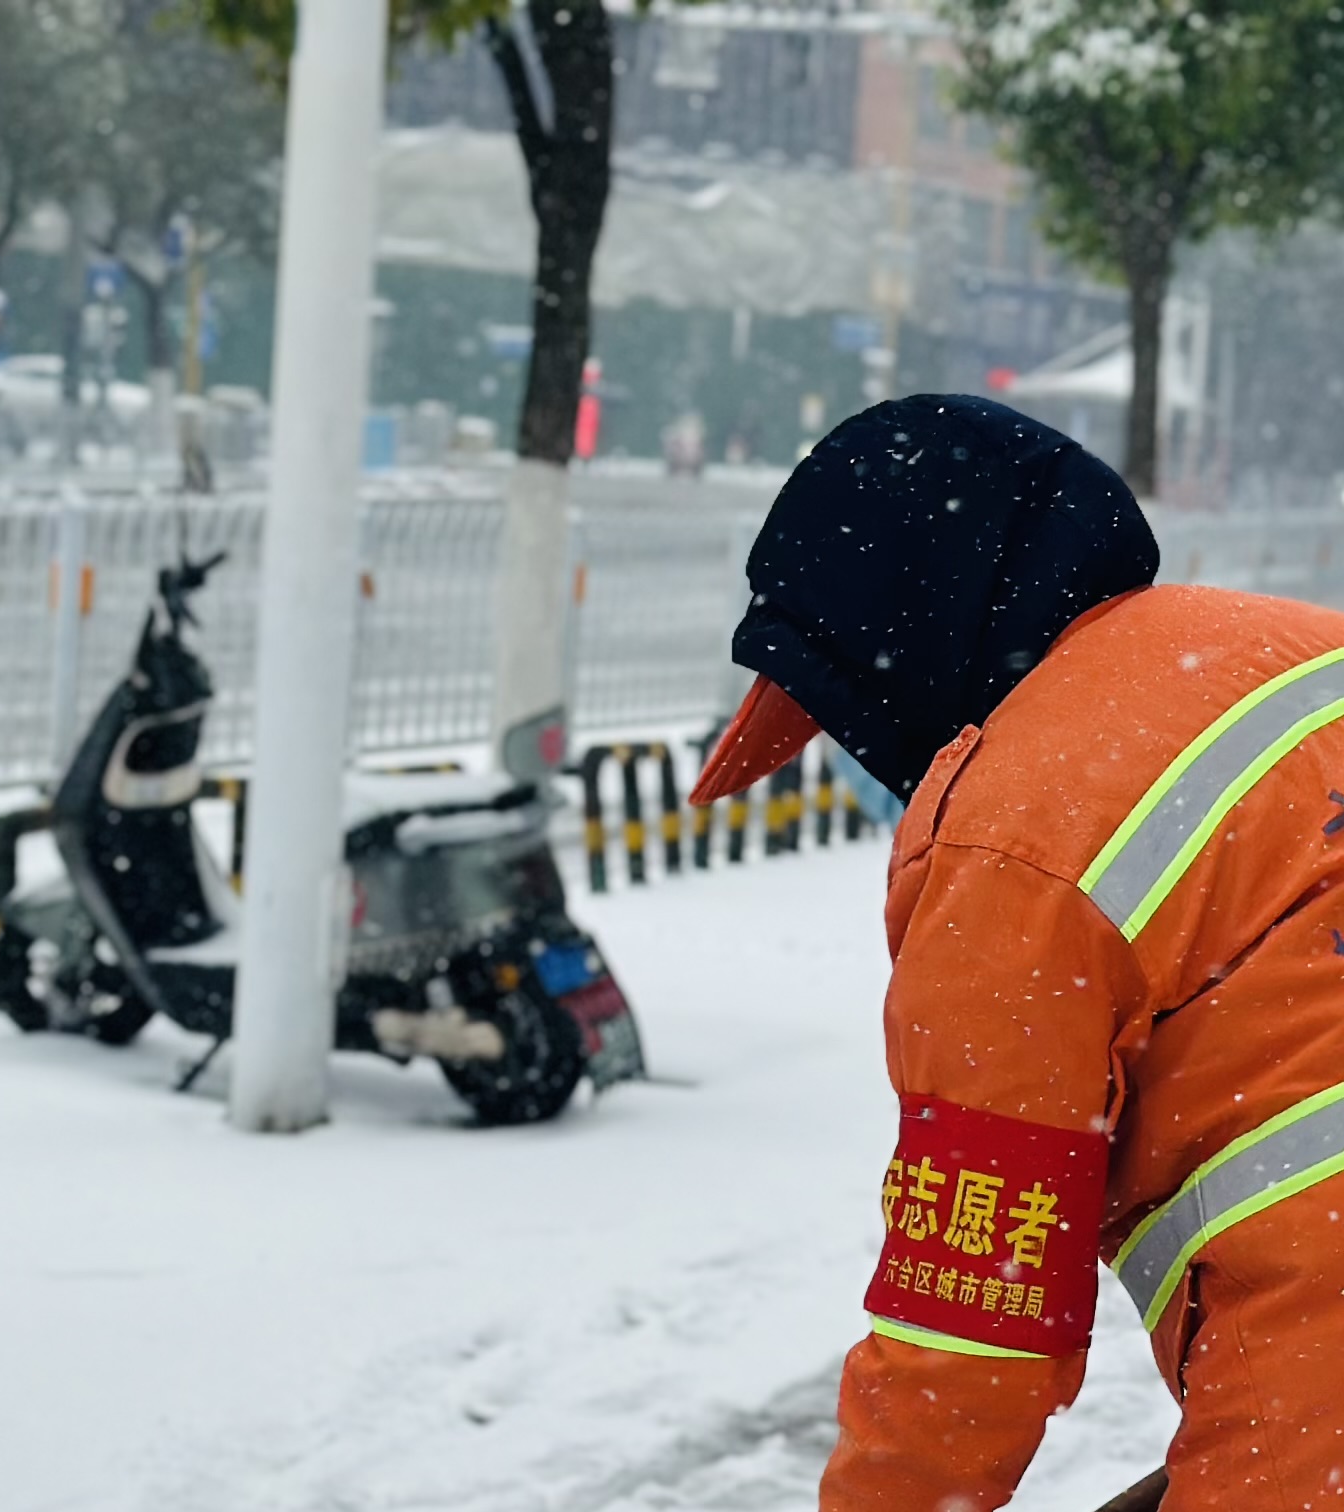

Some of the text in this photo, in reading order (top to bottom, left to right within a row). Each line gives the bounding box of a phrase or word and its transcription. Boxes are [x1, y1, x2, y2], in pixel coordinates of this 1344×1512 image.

[883, 1253, 1045, 1319] 六合区城市管理局
